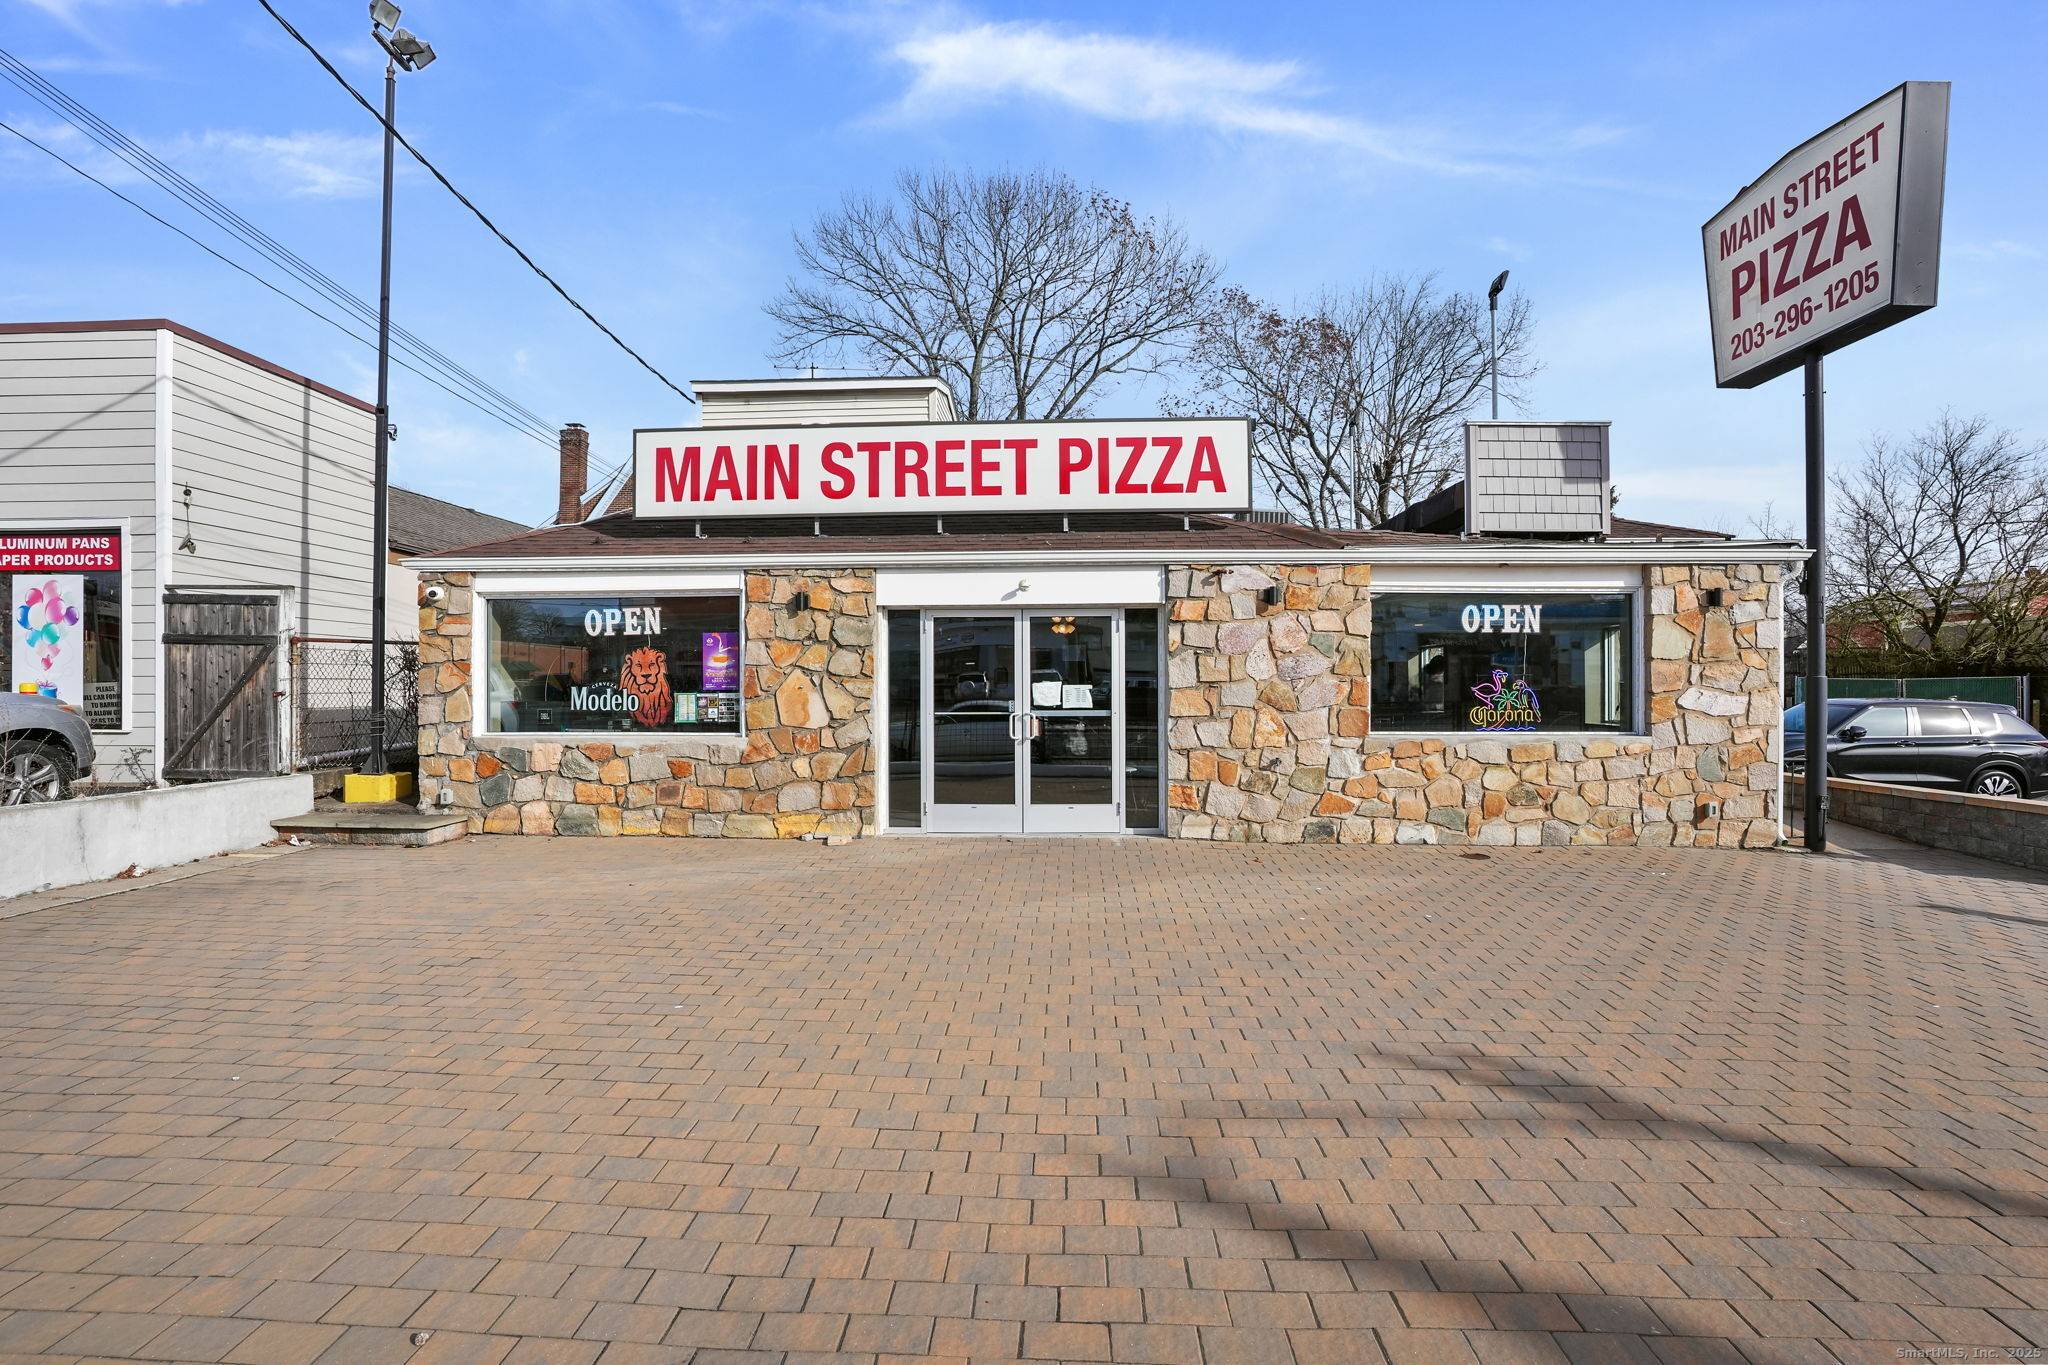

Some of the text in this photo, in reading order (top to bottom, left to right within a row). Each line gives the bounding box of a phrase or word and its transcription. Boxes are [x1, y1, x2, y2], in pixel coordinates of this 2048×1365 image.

[1719, 122, 1885, 262] MAIN STREET
[1731, 193, 1872, 321] PIZZA
[1730, 260, 1880, 361] 203-296-1205
[654, 436, 1228, 502] MAIN STREET PIZZA
[0, 537, 110, 549] LUMINUM PANS
[0, 554, 114, 566] PER PRODUCTS
[584, 606, 662, 637] OPEN
[1461, 604, 1542, 634] OPEN
[570, 686, 639, 711] Modelo
[591, 681, 617, 690] CERVEZA
[1469, 705, 1534, 727] Corona
